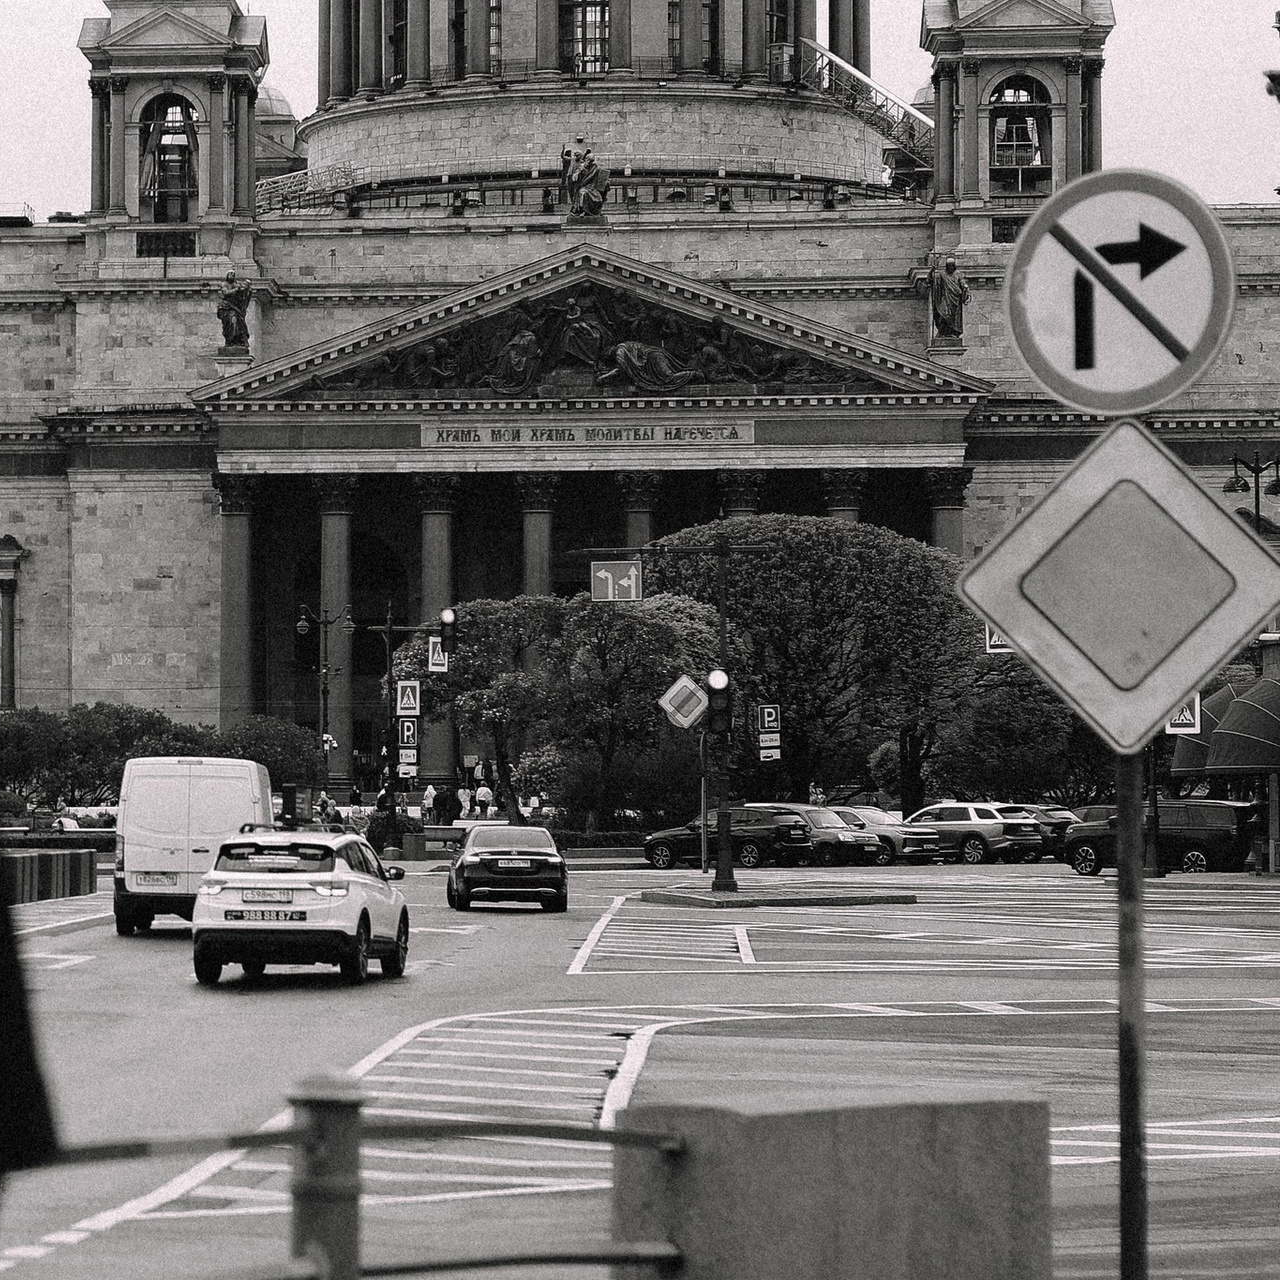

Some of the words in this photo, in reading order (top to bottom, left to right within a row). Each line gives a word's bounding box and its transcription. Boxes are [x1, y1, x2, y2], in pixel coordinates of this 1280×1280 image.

[764, 708, 776, 728] P
[404, 721, 414, 743] P
[243, 910, 262, 920] 988
[263, 910, 277, 920] 88
[278, 910, 292, 920] 87
